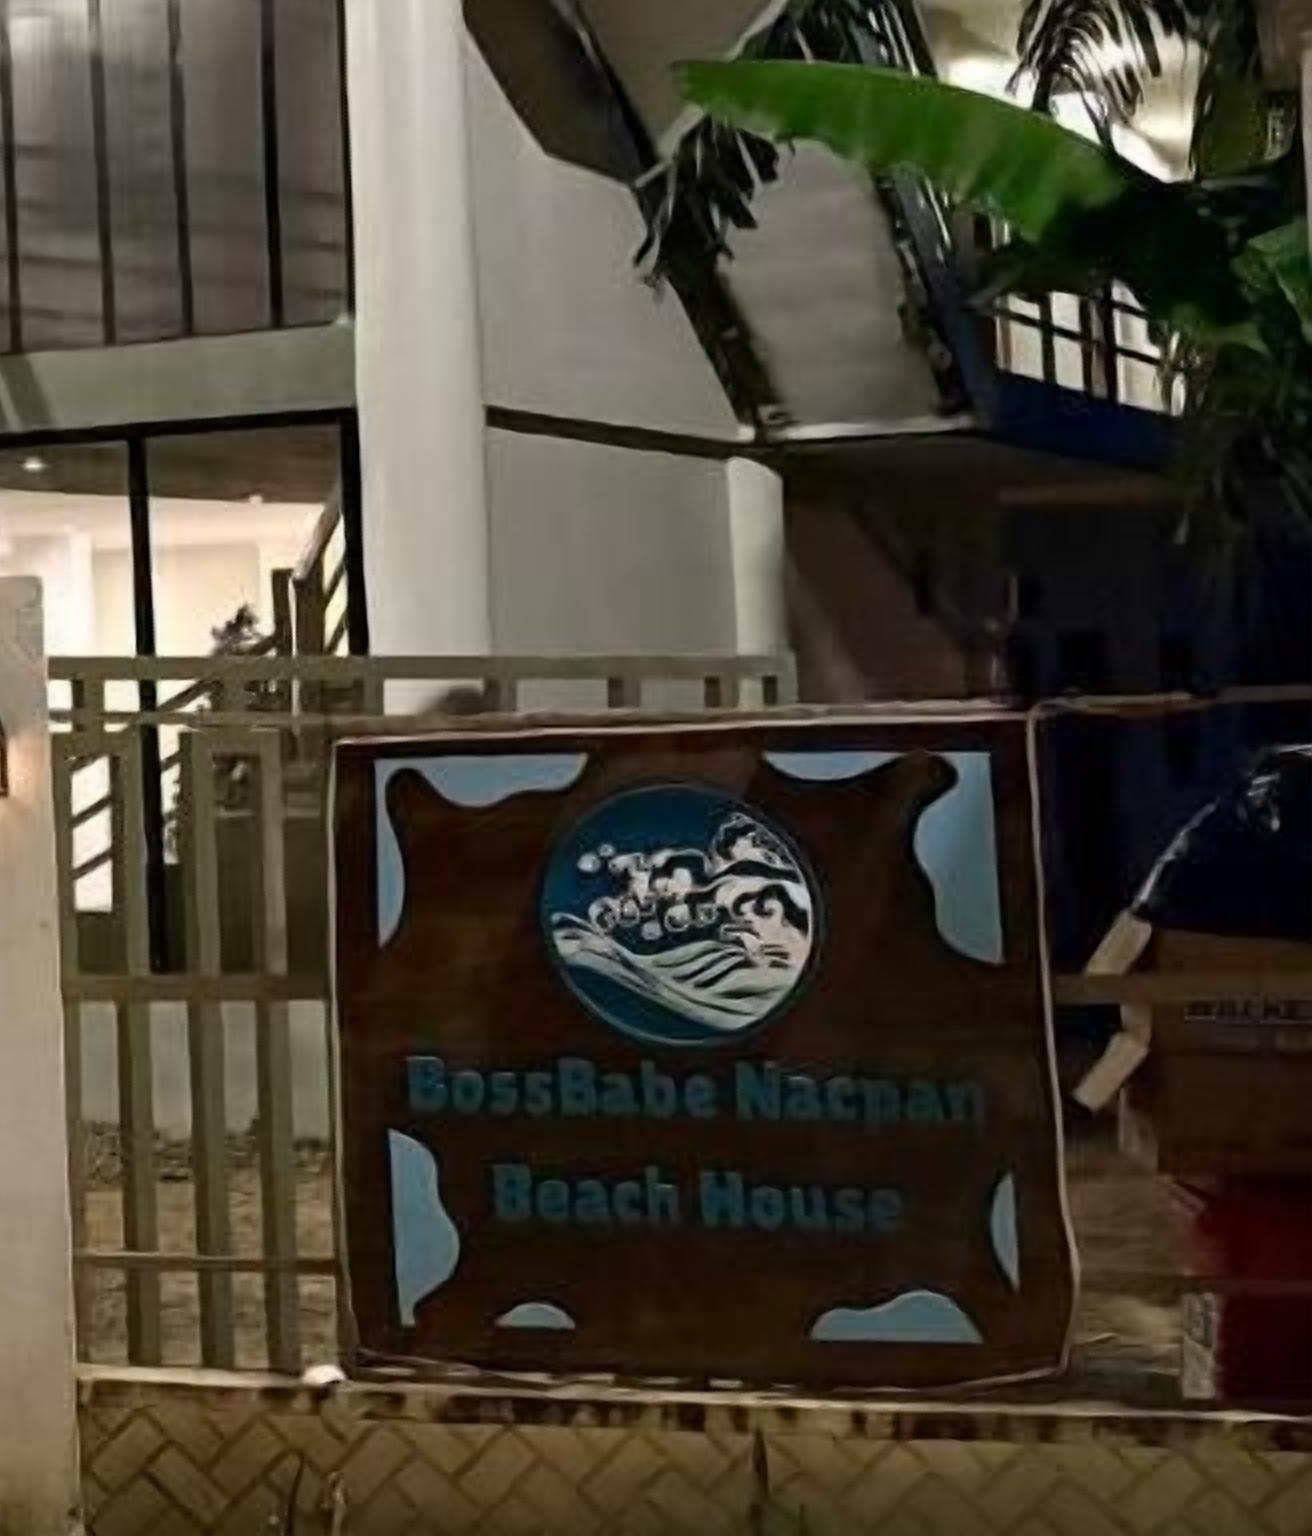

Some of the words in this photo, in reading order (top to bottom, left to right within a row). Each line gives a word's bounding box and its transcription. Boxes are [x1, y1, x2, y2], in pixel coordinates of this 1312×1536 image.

[406, 1055, 721, 1120] BossBabe
[734, 1057, 986, 1136] Nacpan
[491, 1161, 682, 1227] Beach
[698, 1168, 904, 1233] House
